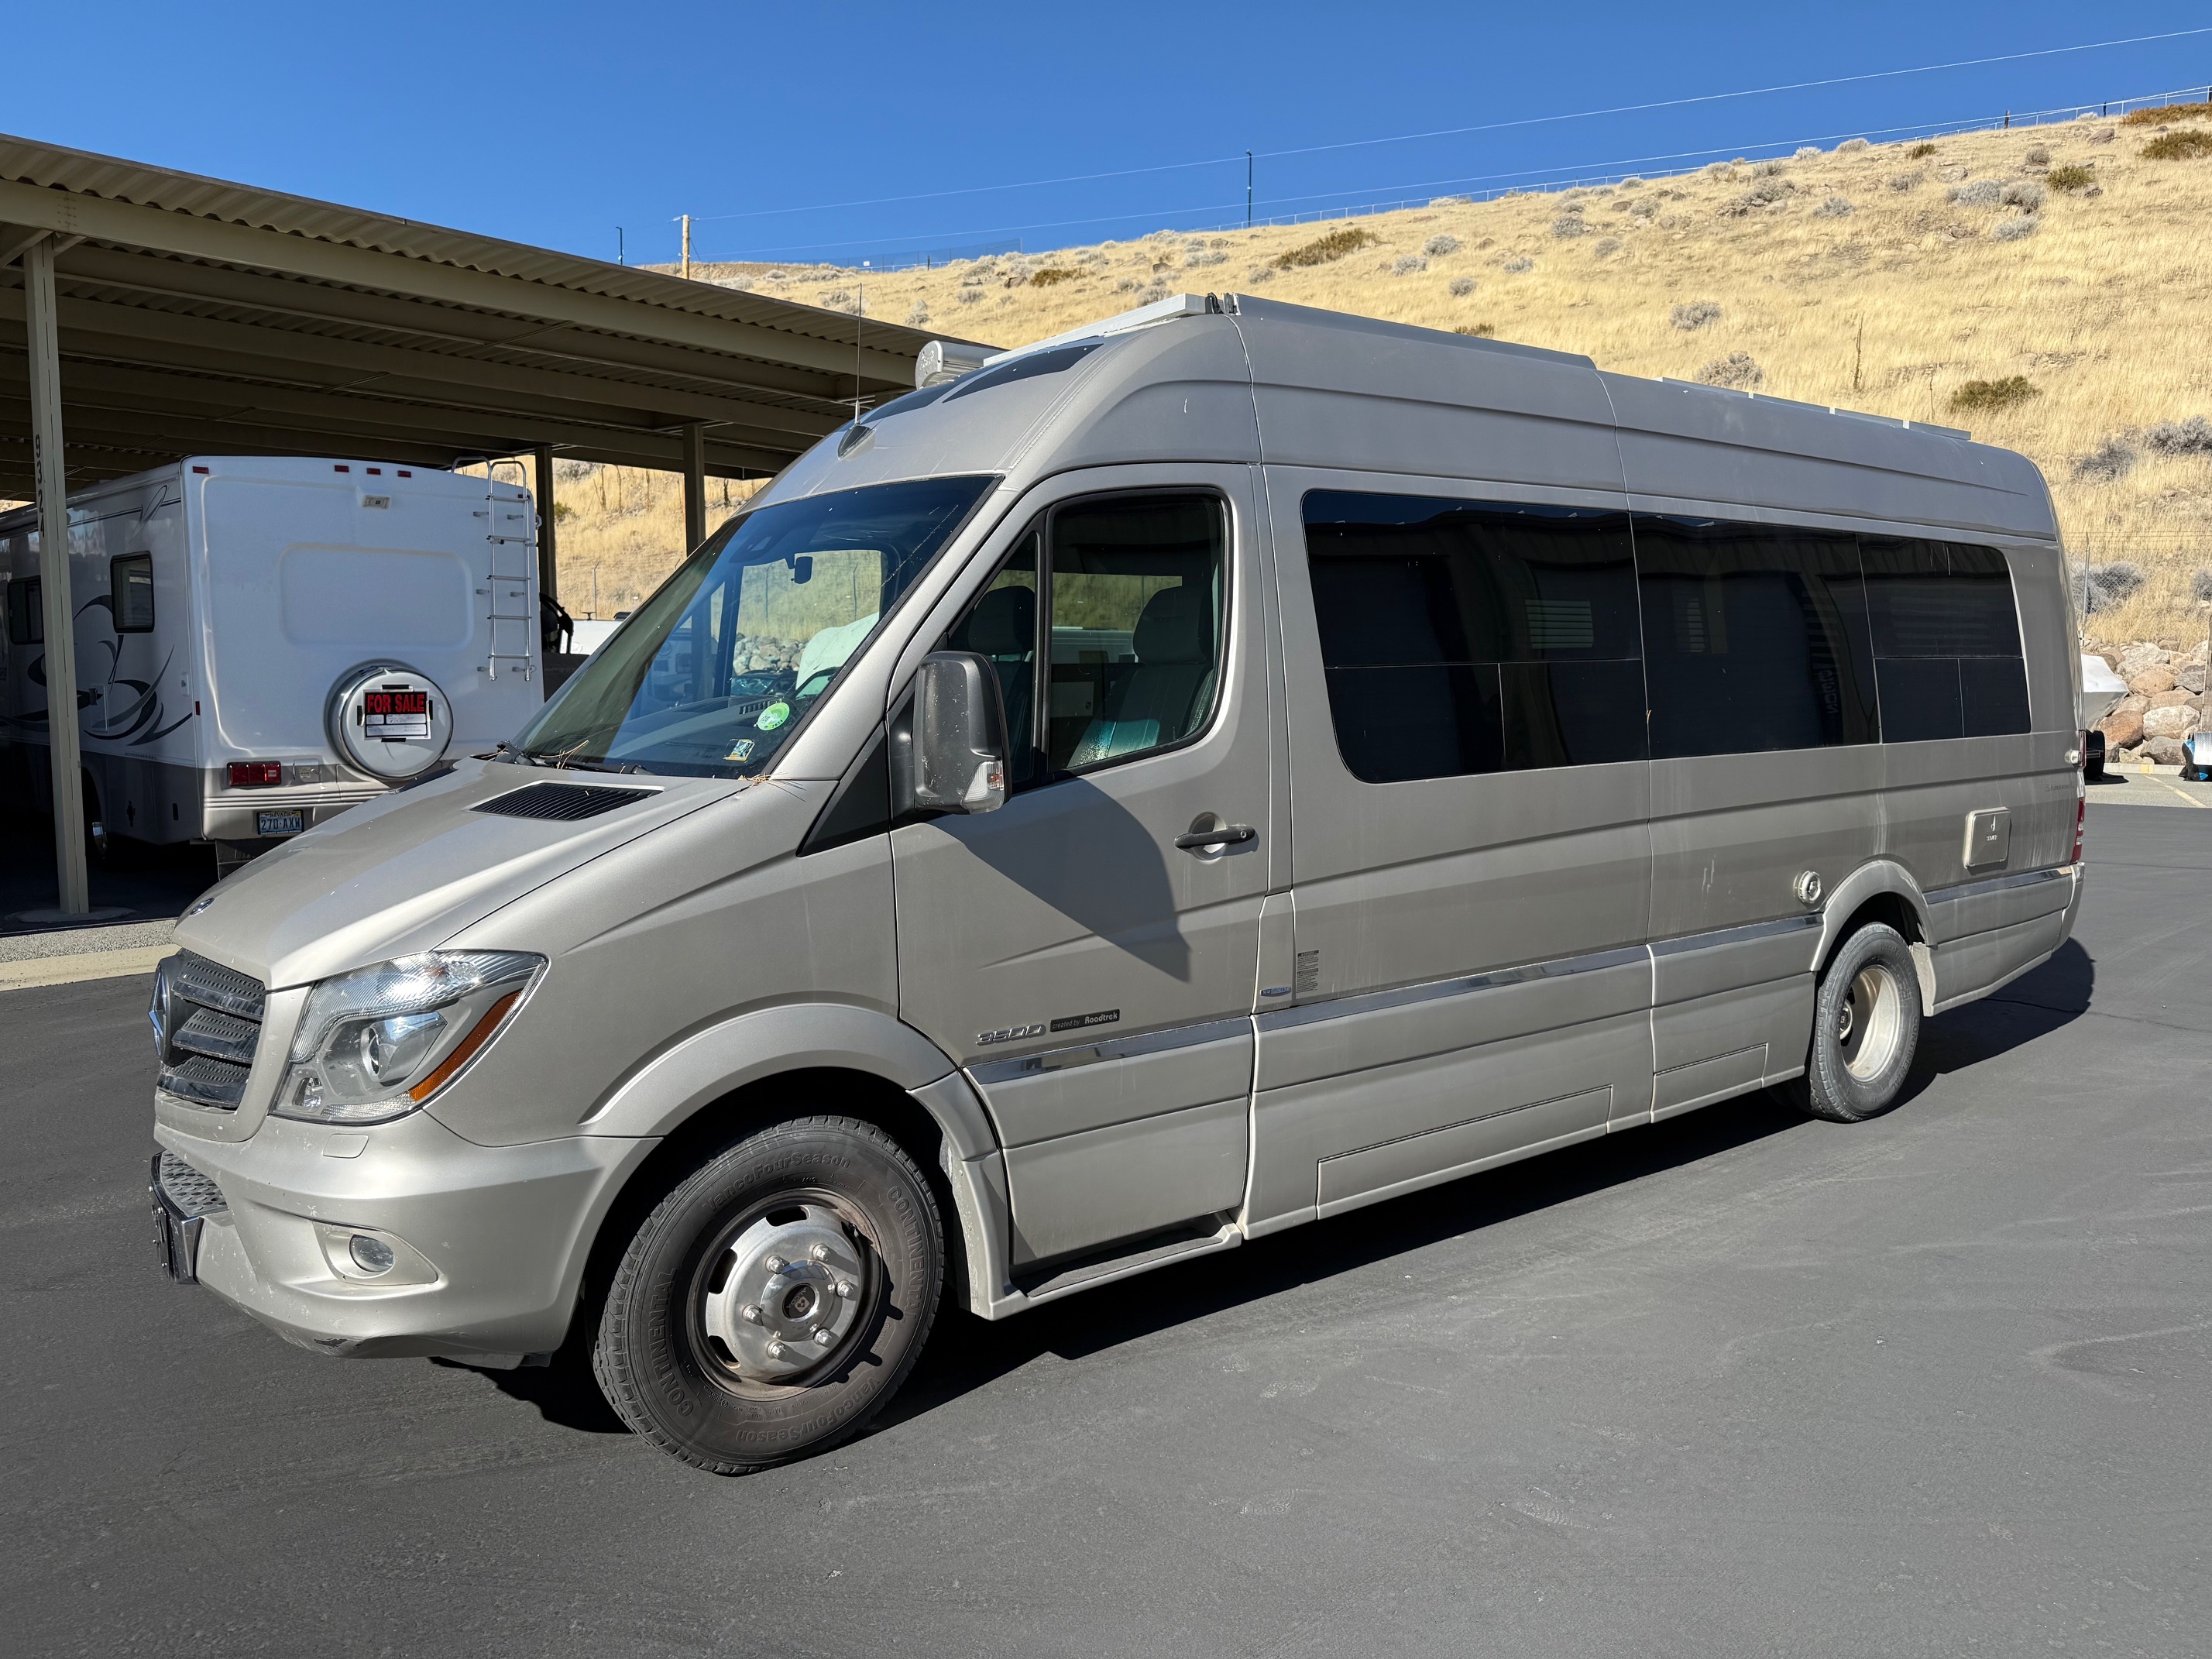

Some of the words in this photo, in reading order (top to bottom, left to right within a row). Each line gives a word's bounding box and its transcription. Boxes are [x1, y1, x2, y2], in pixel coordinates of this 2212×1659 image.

[367, 694, 391, 713] FOR
[395, 694, 424, 713] SALE
[1052, 1019, 1073, 1030] created
[1073, 1018, 1080, 1027] by
[1084, 1012, 1118, 1025] Roadtrek
[975, 1024, 1046, 1046] 3500
[887, 1186, 926, 1324] CONTINENTAL
[647, 1268, 694, 1417] CONTINENTAL
